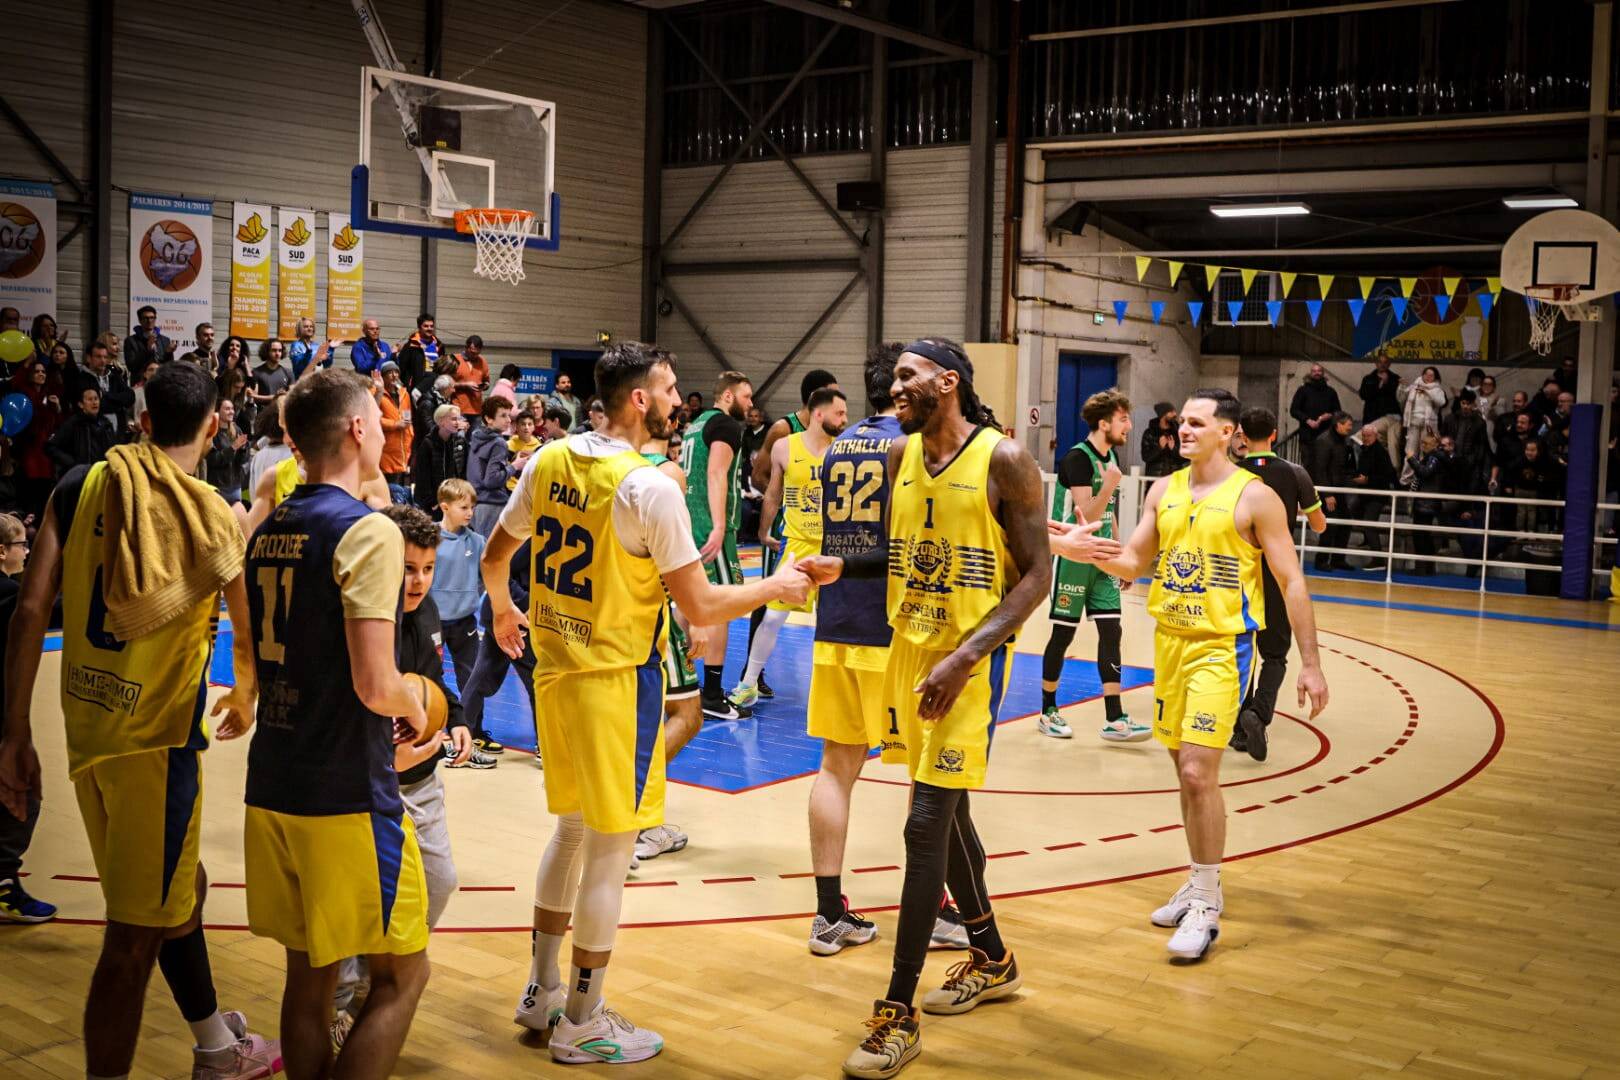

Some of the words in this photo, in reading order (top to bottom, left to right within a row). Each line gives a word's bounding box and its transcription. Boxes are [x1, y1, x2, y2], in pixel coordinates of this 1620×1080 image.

[173, 201, 210, 211] 2014/2015
[242, 246, 260, 255] PACA
[288, 250, 305, 259] SUD
[338, 254, 353, 263] SUD
[1429, 340, 1457, 350] CLUB
[549, 481, 589, 513] PAOLI
[827, 460, 884, 522] 32
[924, 498, 934, 529] 1
[536, 515, 594, 602] 22
[901, 602, 946, 620] OSCAR
[1163, 601, 1203, 616] OSCAR
[1156, 698, 1164, 721] 7
[888, 707, 900, 735] 1
